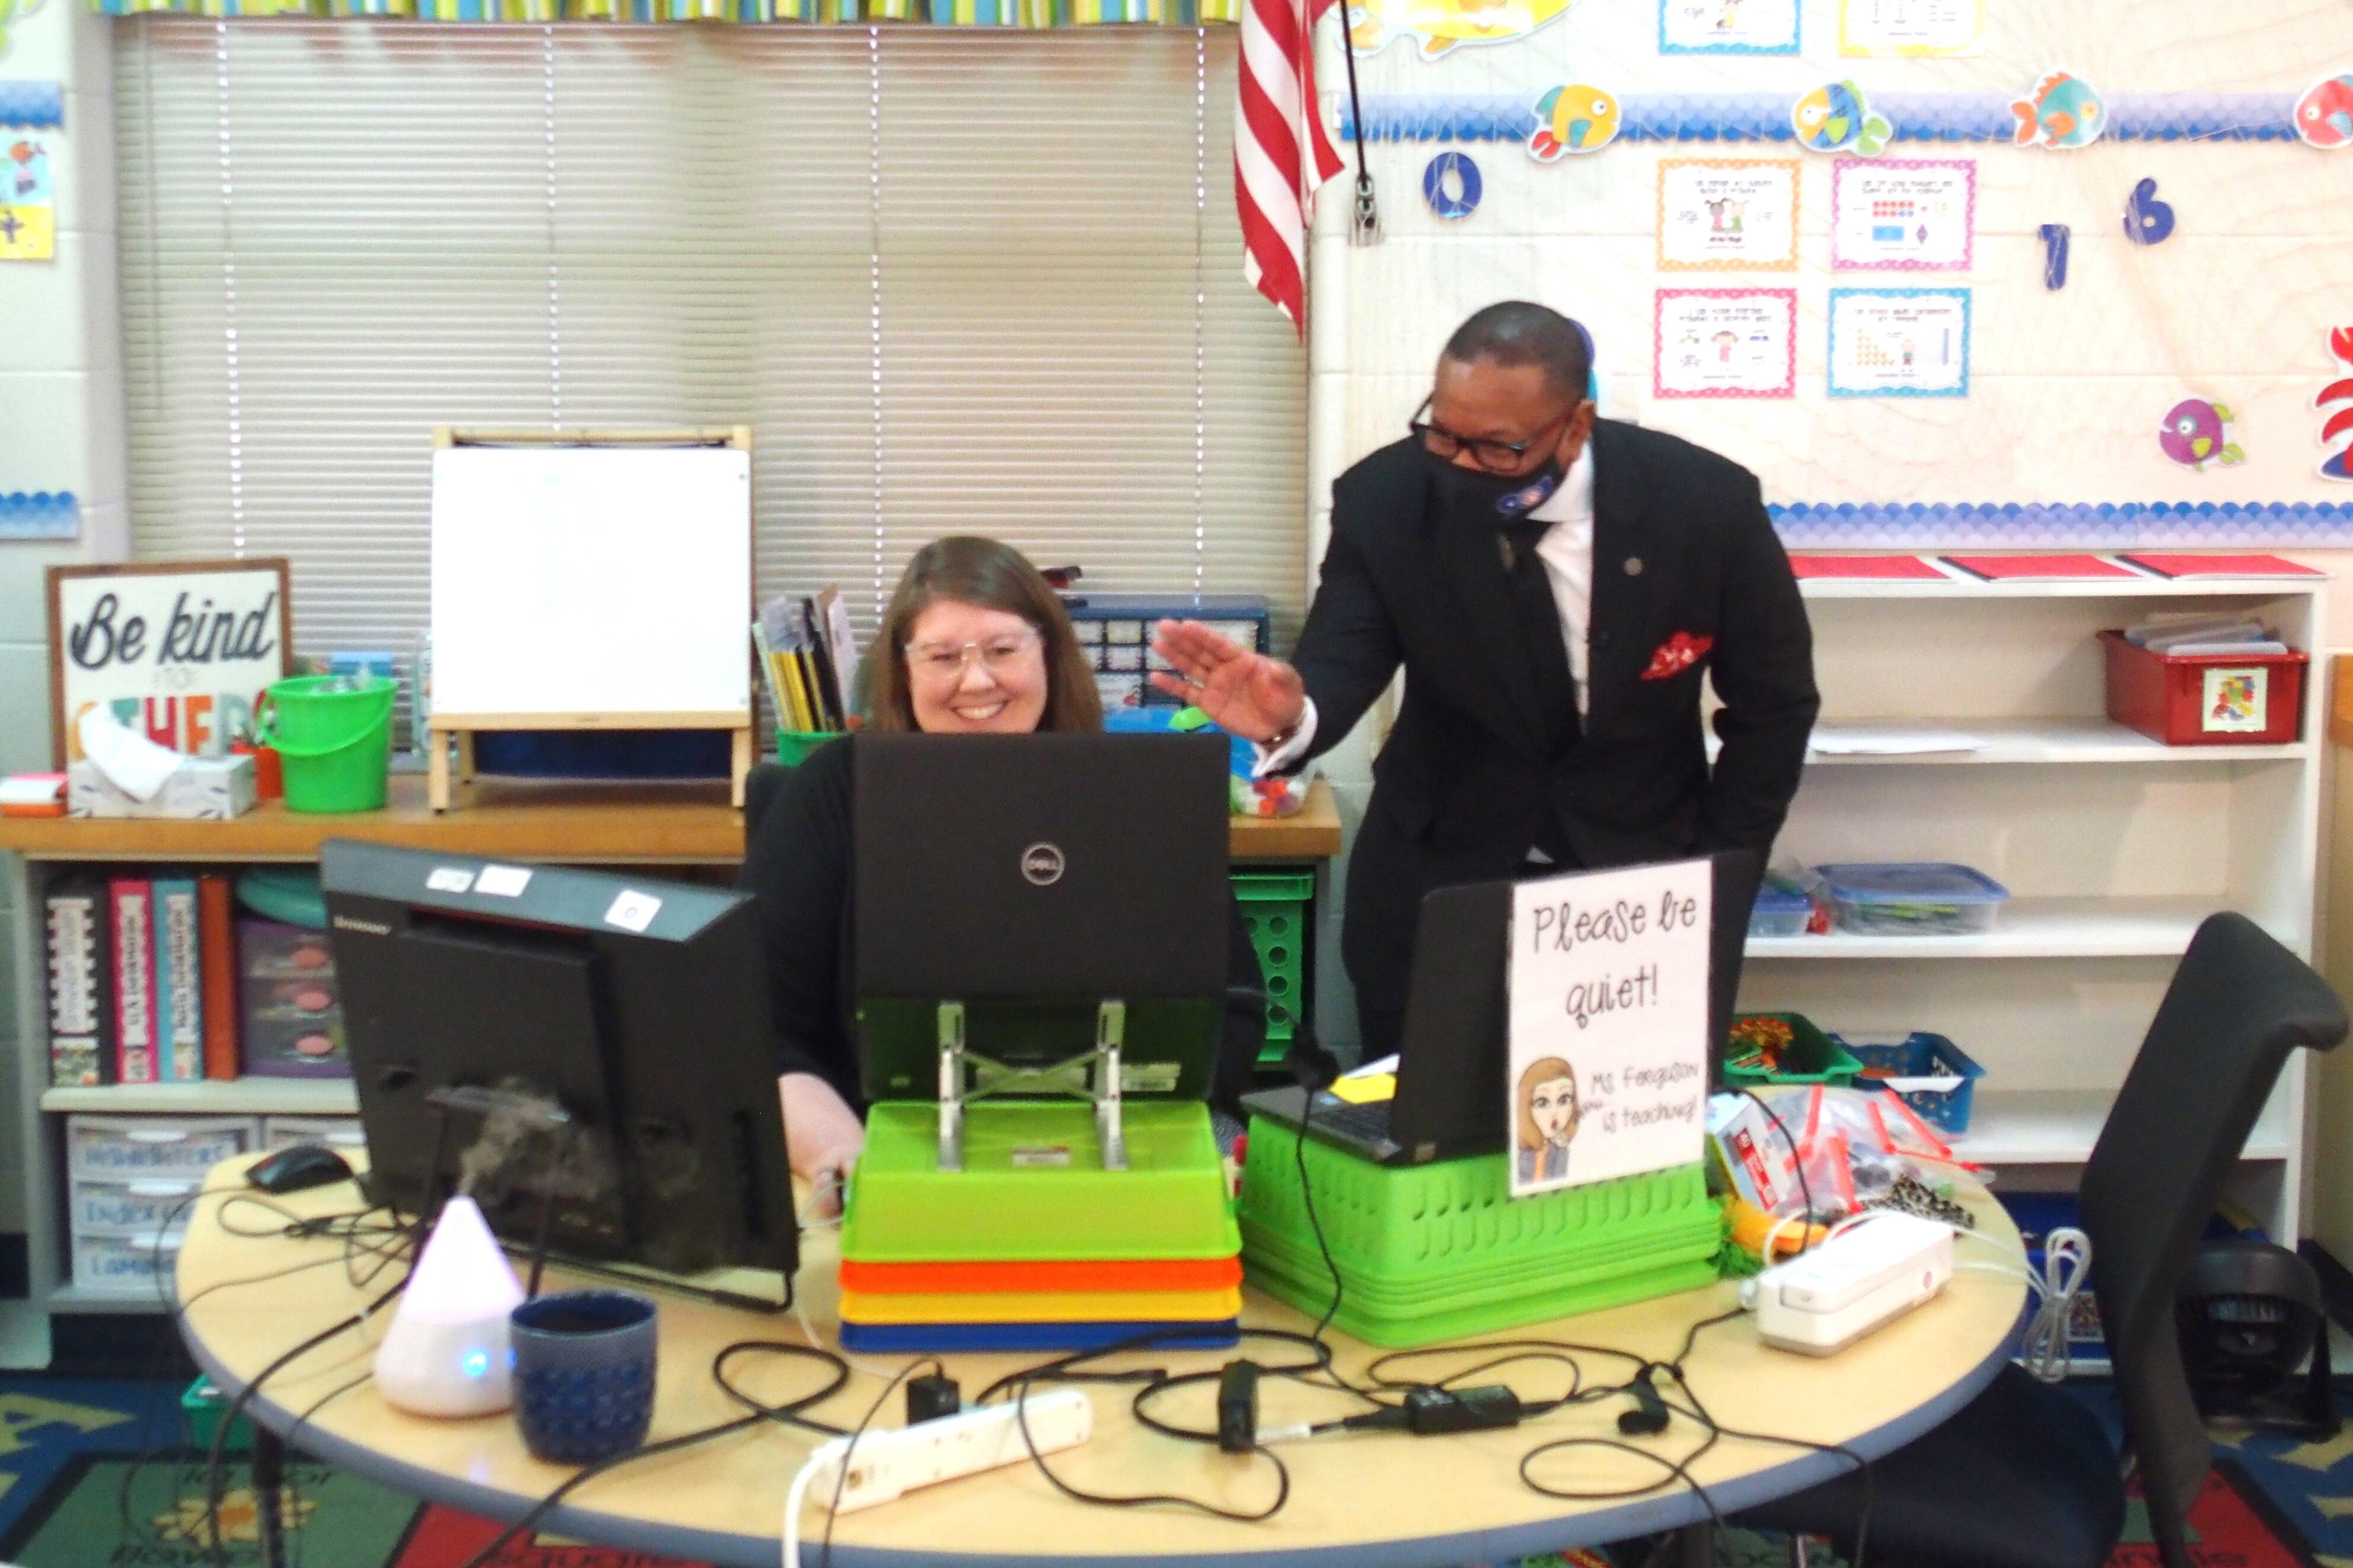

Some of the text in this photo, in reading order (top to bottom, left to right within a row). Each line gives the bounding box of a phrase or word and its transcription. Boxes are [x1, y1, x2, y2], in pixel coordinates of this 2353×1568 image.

[2124, 177, 2175, 245] 6
[69, 592, 277, 671] Be kind
[1533, 889, 1697, 953] Please be
[1566, 963, 1657, 1029] quiet!
